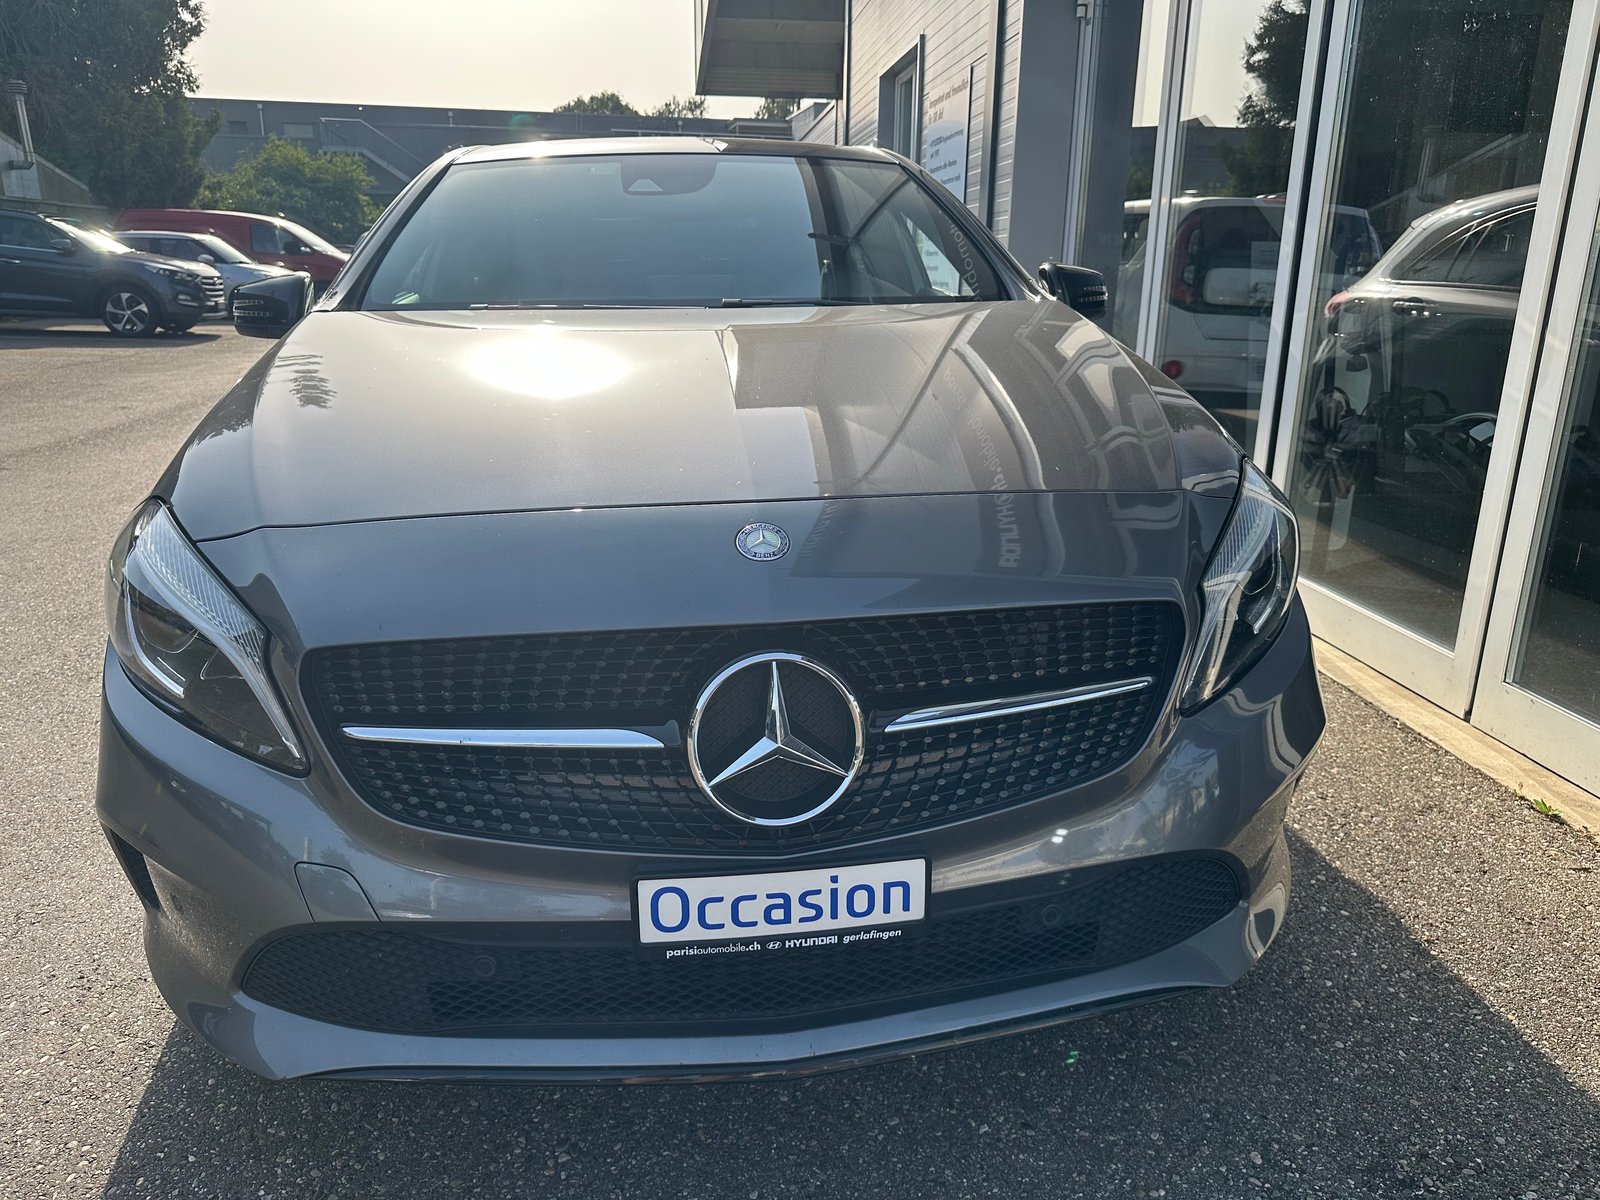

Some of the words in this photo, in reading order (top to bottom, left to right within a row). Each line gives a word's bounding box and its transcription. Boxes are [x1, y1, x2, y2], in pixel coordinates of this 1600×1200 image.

[650, 874, 911, 933] Occasion
[666, 942, 761, 959] parisiautomobile.ch
[785, 935, 839, 949] HYUNDAI
[843, 929, 902, 944] gerlafingen
